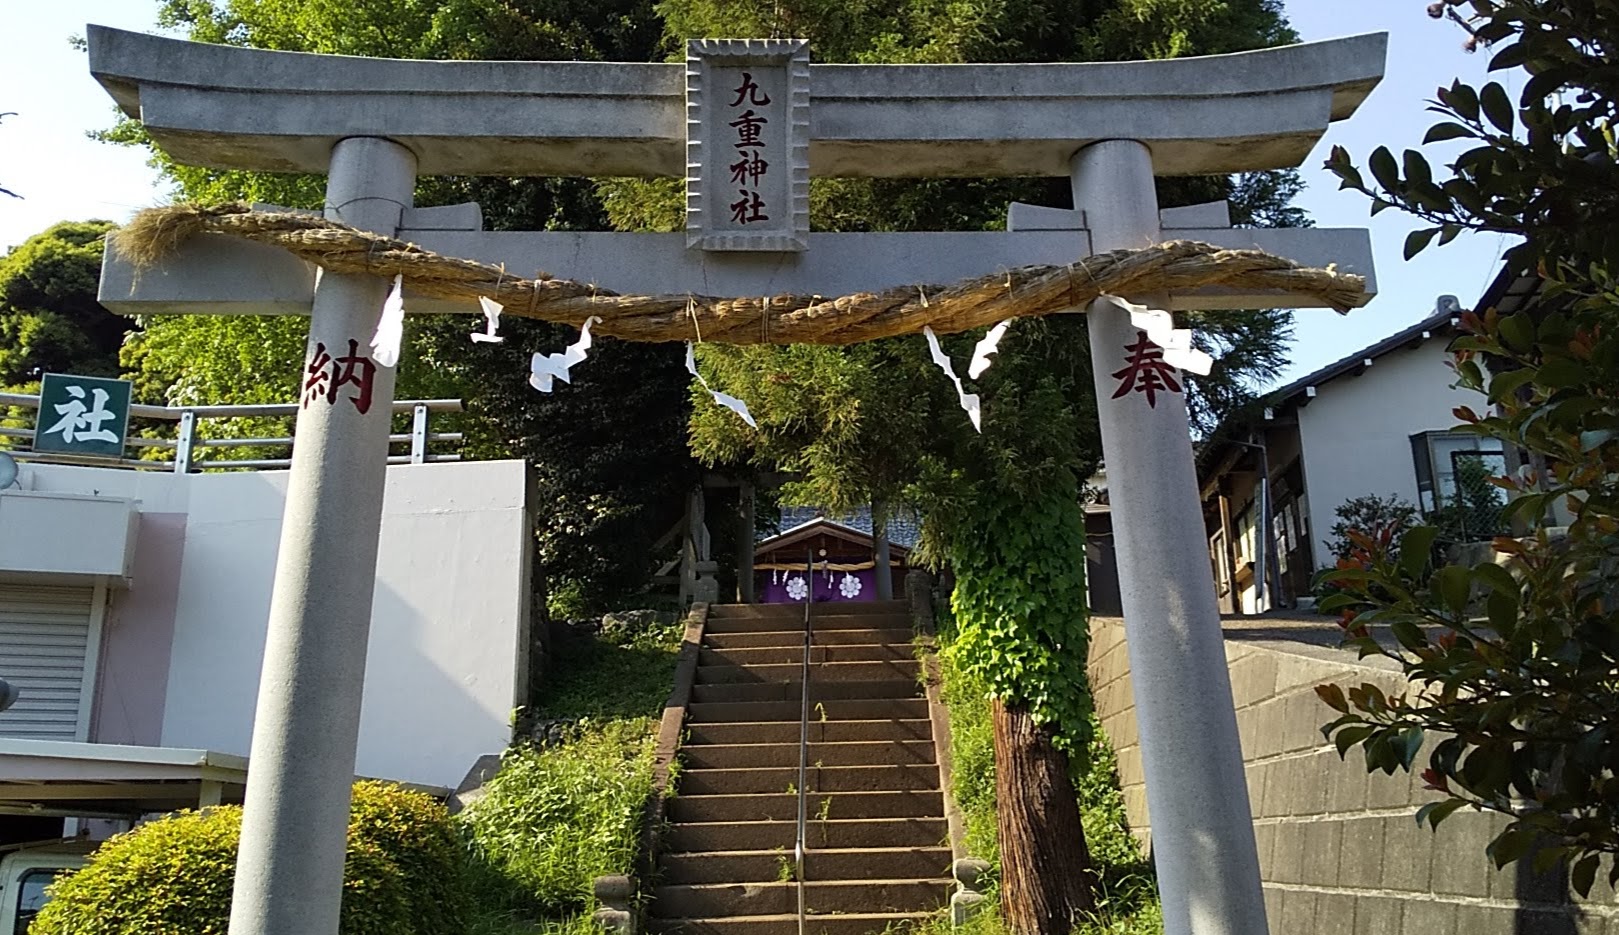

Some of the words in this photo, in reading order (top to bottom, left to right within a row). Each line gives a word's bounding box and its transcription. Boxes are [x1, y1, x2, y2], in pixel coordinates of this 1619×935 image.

[729, 72, 771, 225] 九重神社
[304, 339, 376, 415] 納
[1111, 331, 1182, 409] 奉
[43, 385, 119, 444] 社
